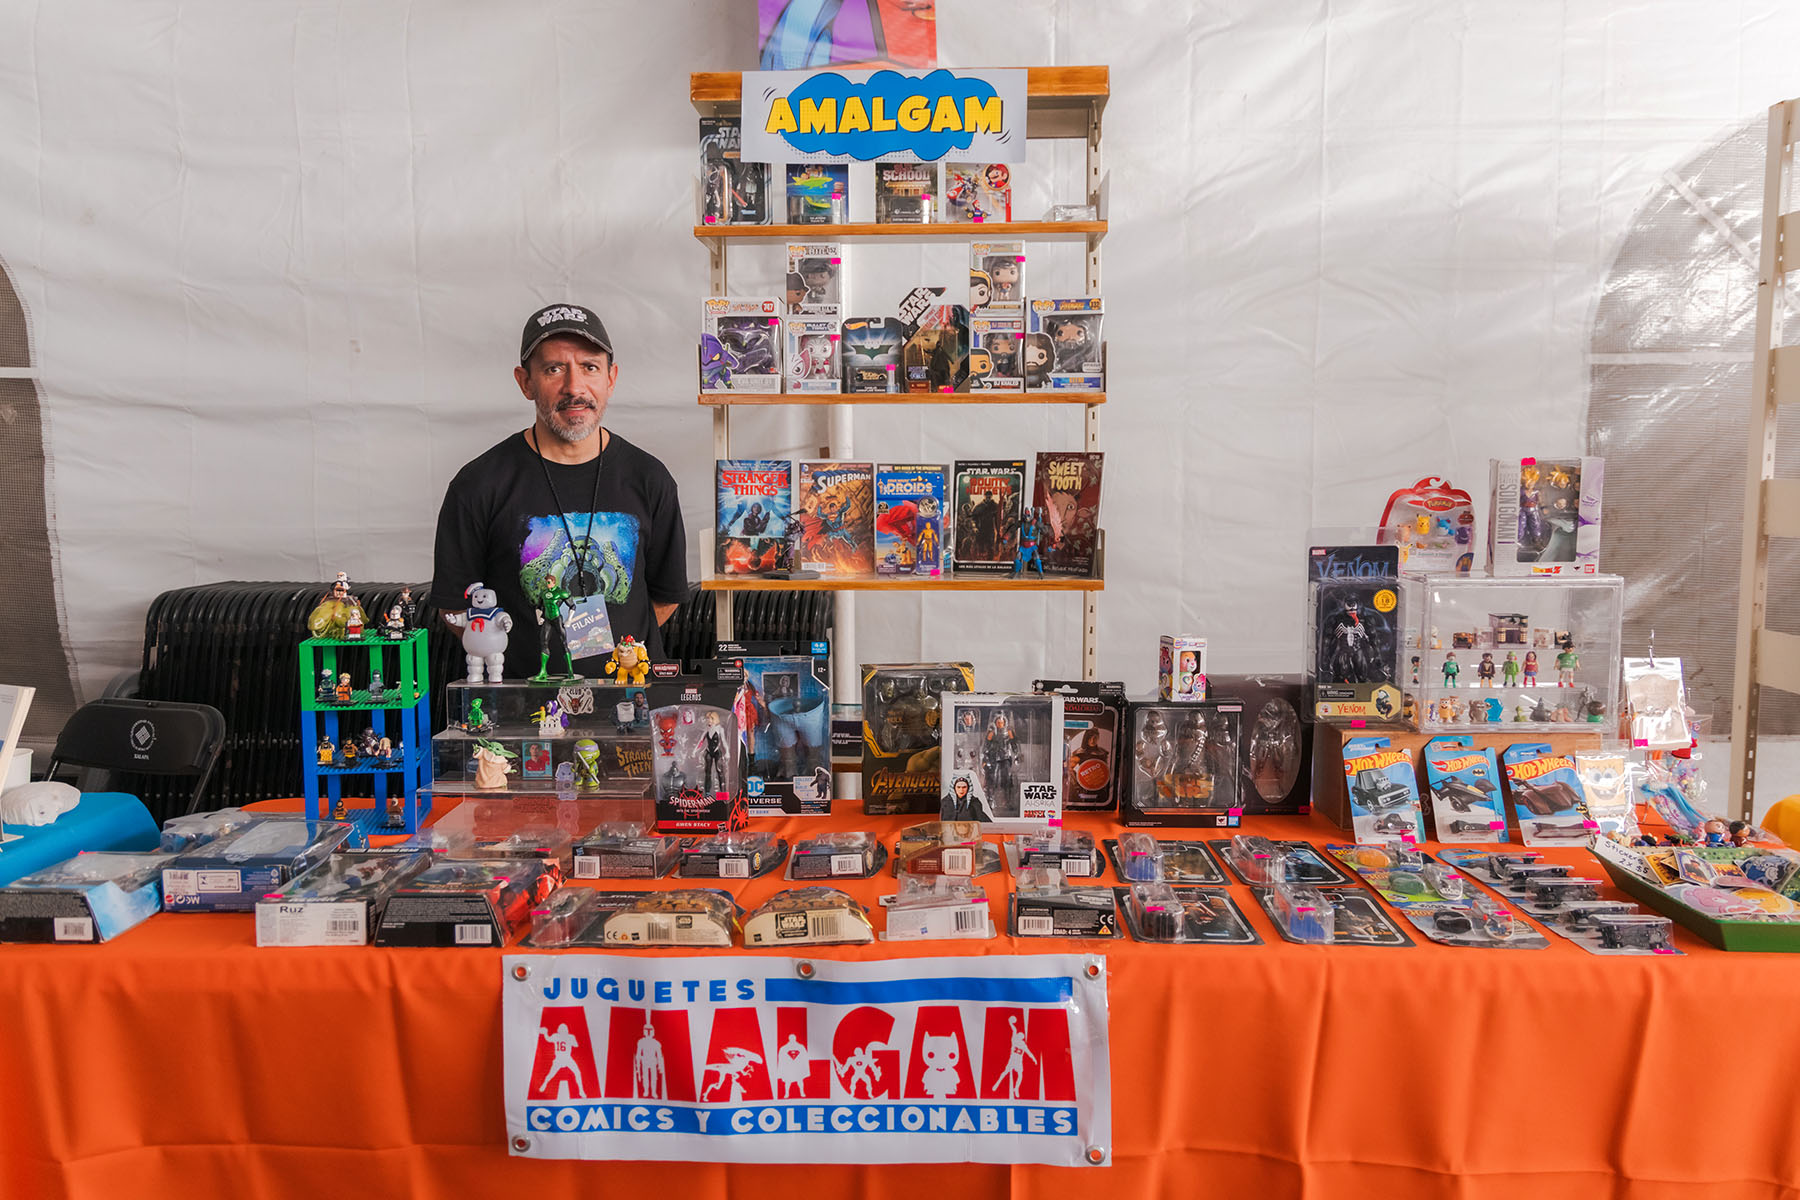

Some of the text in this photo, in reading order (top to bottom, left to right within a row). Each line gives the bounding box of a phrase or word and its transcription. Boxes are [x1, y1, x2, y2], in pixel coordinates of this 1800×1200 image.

[765, 94, 1005, 135] AMALGAM
[718, 127, 742, 138] STA
[717, 138, 742, 149] WA
[543, 307, 583, 317] STAR
[537, 313, 588, 327] WARS
[1048, 460, 1086, 475] SWEET
[722, 471, 789, 488] STRANGER
[817, 473, 872, 494] SUPERMAN
[970, 477, 1011, 487] BOUNTY
[1049, 475, 1083, 491] TOOTH
[732, 485, 779, 496] THINGS
[887, 482, 933, 493] DROIDS
[1499, 483, 1517, 505] SON
[1498, 507, 1517, 540] GOHAN
[1316, 553, 1389, 583] VENOM
[571, 615, 595, 632] FILAV
[718, 644, 728, 652] 22
[680, 693, 702, 701] LEGENDS
[1337, 703, 1366, 715] VENOM
[615, 745, 653, 768] STRANG
[623, 761, 653, 779] THIN
[747, 780, 763, 793] DC
[1024, 785, 1057, 793] STAR
[669, 794, 716, 809] SPIDER-MAN
[1024, 792, 1057, 800] WARS
[1604, 840, 1644, 866] Stickers
[280, 905, 304, 913] Ruz
[543, 977, 756, 1002] JUGUETES
[527, 1005, 1077, 1102] AMALGAM
[555, 1041, 567, 1052] 16
[530, 1106, 1073, 1135] COMICS Y COLECCIONABLES
